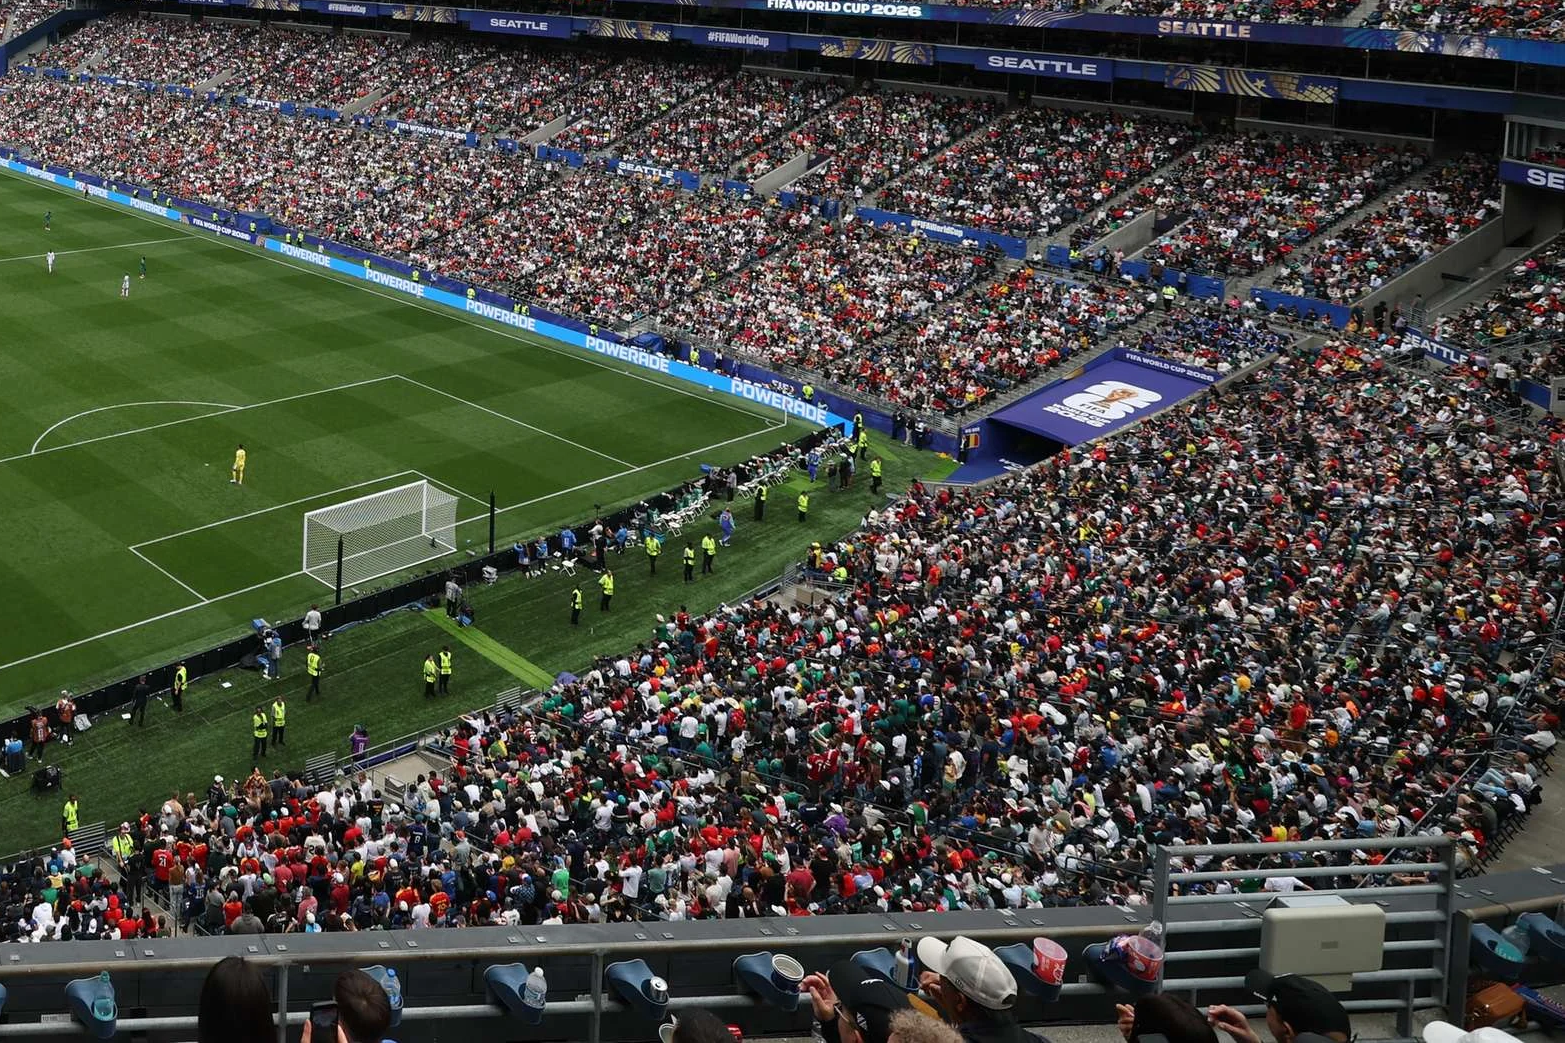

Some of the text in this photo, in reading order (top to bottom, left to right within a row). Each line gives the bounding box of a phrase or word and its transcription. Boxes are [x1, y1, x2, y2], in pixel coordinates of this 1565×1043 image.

[795, 0, 841, 13] WORLD
[843, 2, 870, 15] CUP
[871, 4, 922, 18] 2026
[490, 18, 548, 31] SEATTLE
[1158, 20, 1251, 38] SEATTLE
[708, 31, 770, 48] #FIFAWorldCup
[988, 56, 1098, 76] SEATTLE
[246, 98, 280, 107] SEATTLE
[618, 161, 674, 179] SEATTLE
[130, 198, 167, 216] POWERADE
[193, 218, 251, 241] FIFA WORLD CUP 2026
[280, 243, 331, 268] POWERADE
[365, 269, 424, 297] POWERADE
[466, 299, 536, 331] POWERADE
[586, 336, 669, 373] POWERADE
[1402, 331, 1468, 365] SEATTLE
[1126, 353, 1215, 382] FIFA WORLD CUP 2026
[731, 378, 827, 424] POWERADE
[1079, 402, 1106, 414] FIFA
[159, 857, 167, 867] 21
